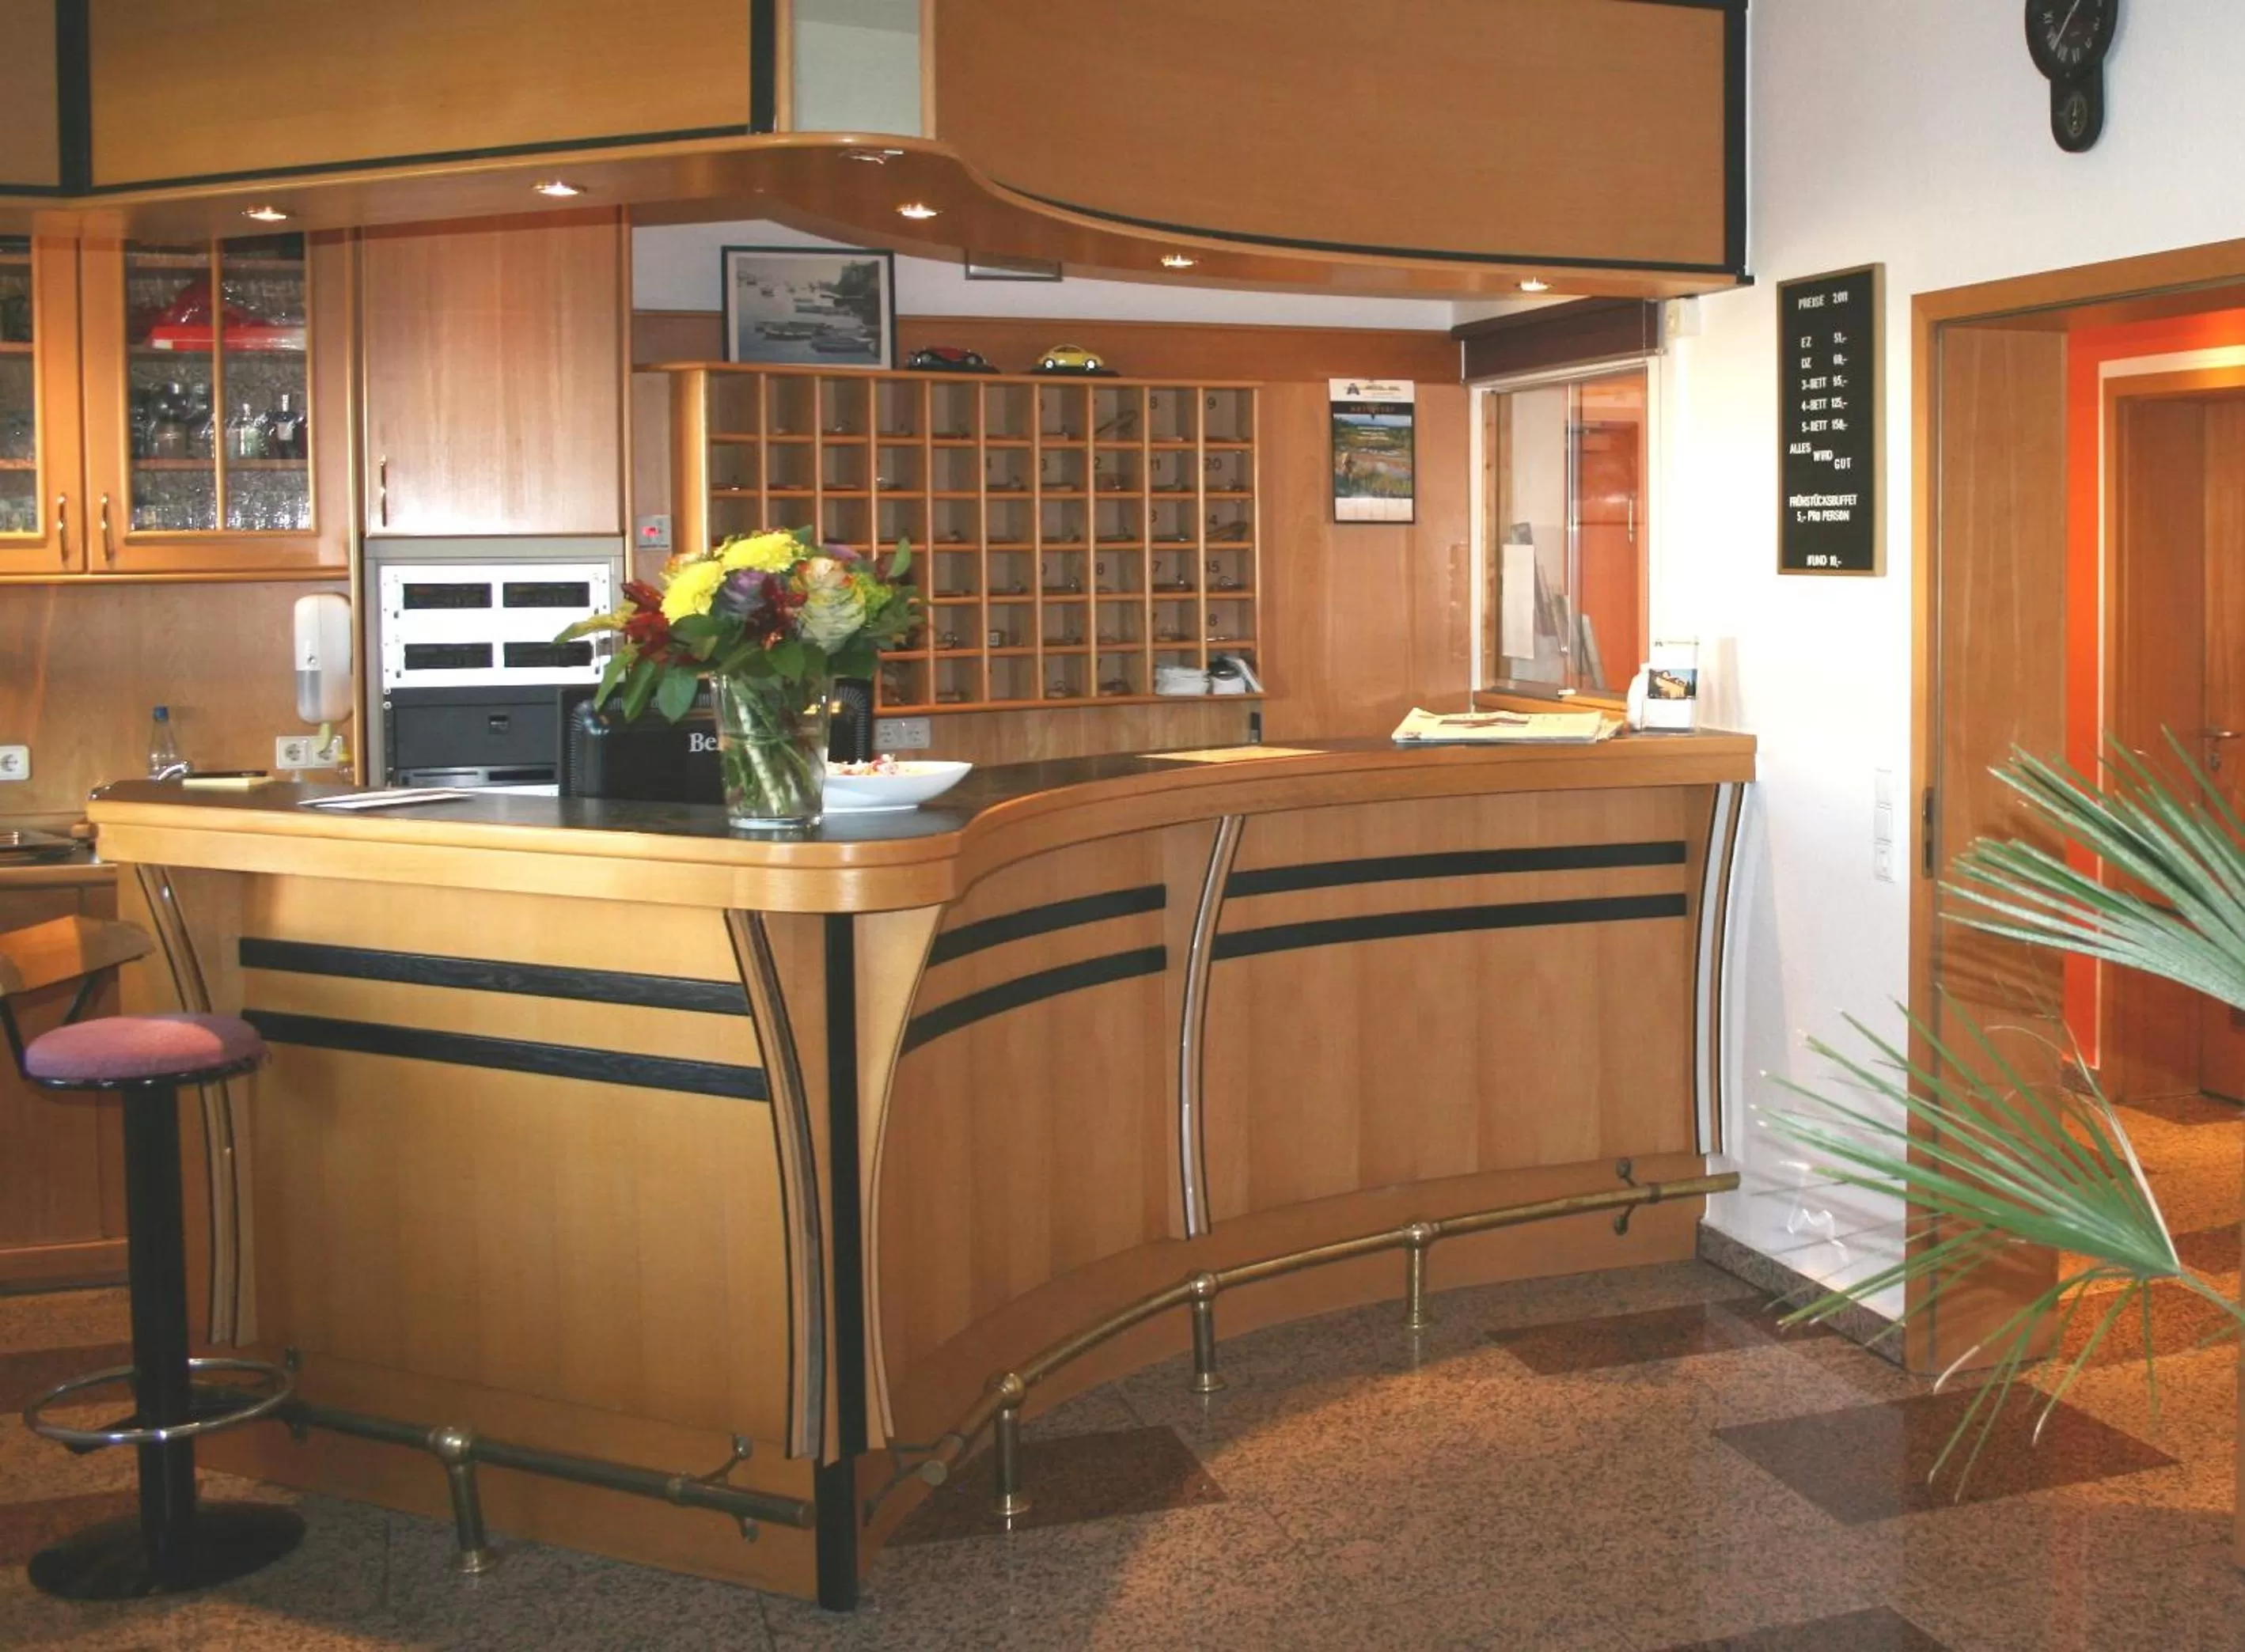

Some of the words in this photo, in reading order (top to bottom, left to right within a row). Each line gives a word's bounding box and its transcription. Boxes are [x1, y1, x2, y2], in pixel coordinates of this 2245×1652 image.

[1798, 294, 1825, 310] PREISE
[1801, 335, 1812, 348] EZ
[1789, 442, 1811, 454] ALLES
[1813, 449, 1834, 462] WIRD
[1834, 457, 1853, 470] GUT
[1822, 510, 1850, 522] PERSON
[688, 732, 720, 752] Be
